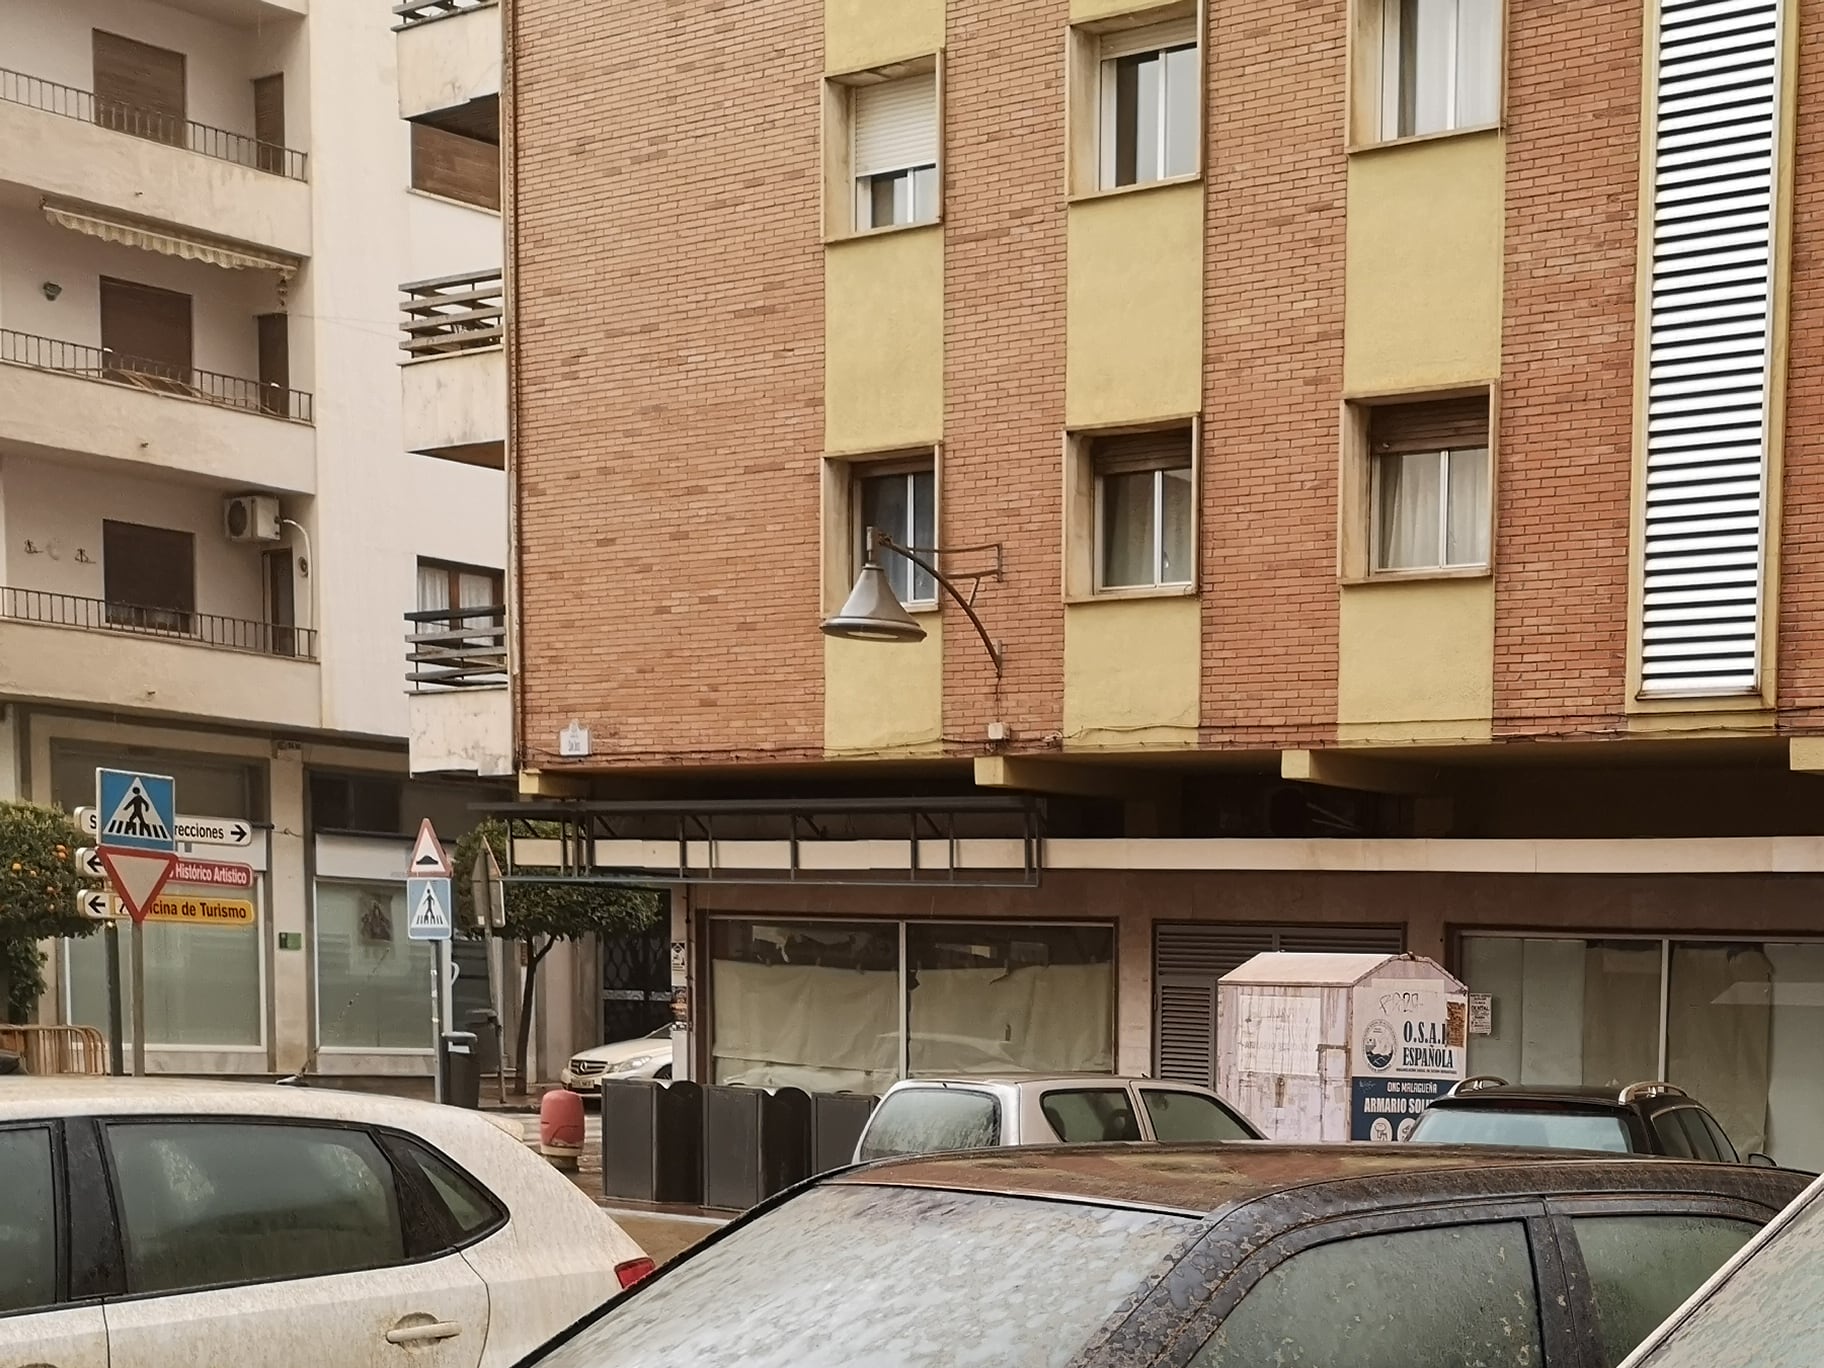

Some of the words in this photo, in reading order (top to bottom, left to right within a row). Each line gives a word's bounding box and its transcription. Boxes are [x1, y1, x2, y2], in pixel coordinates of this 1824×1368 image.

[174, 823, 225, 840] recciones
[175, 862, 213, 881] Histórico
[149, 900, 178, 916] icina
[181, 901, 197, 916] de
[200, 902, 247, 919] Turismo
[1402, 1044, 1454, 1068] ESPAÑOLA
[1364, 1097, 1406, 1114] ARMARIO
